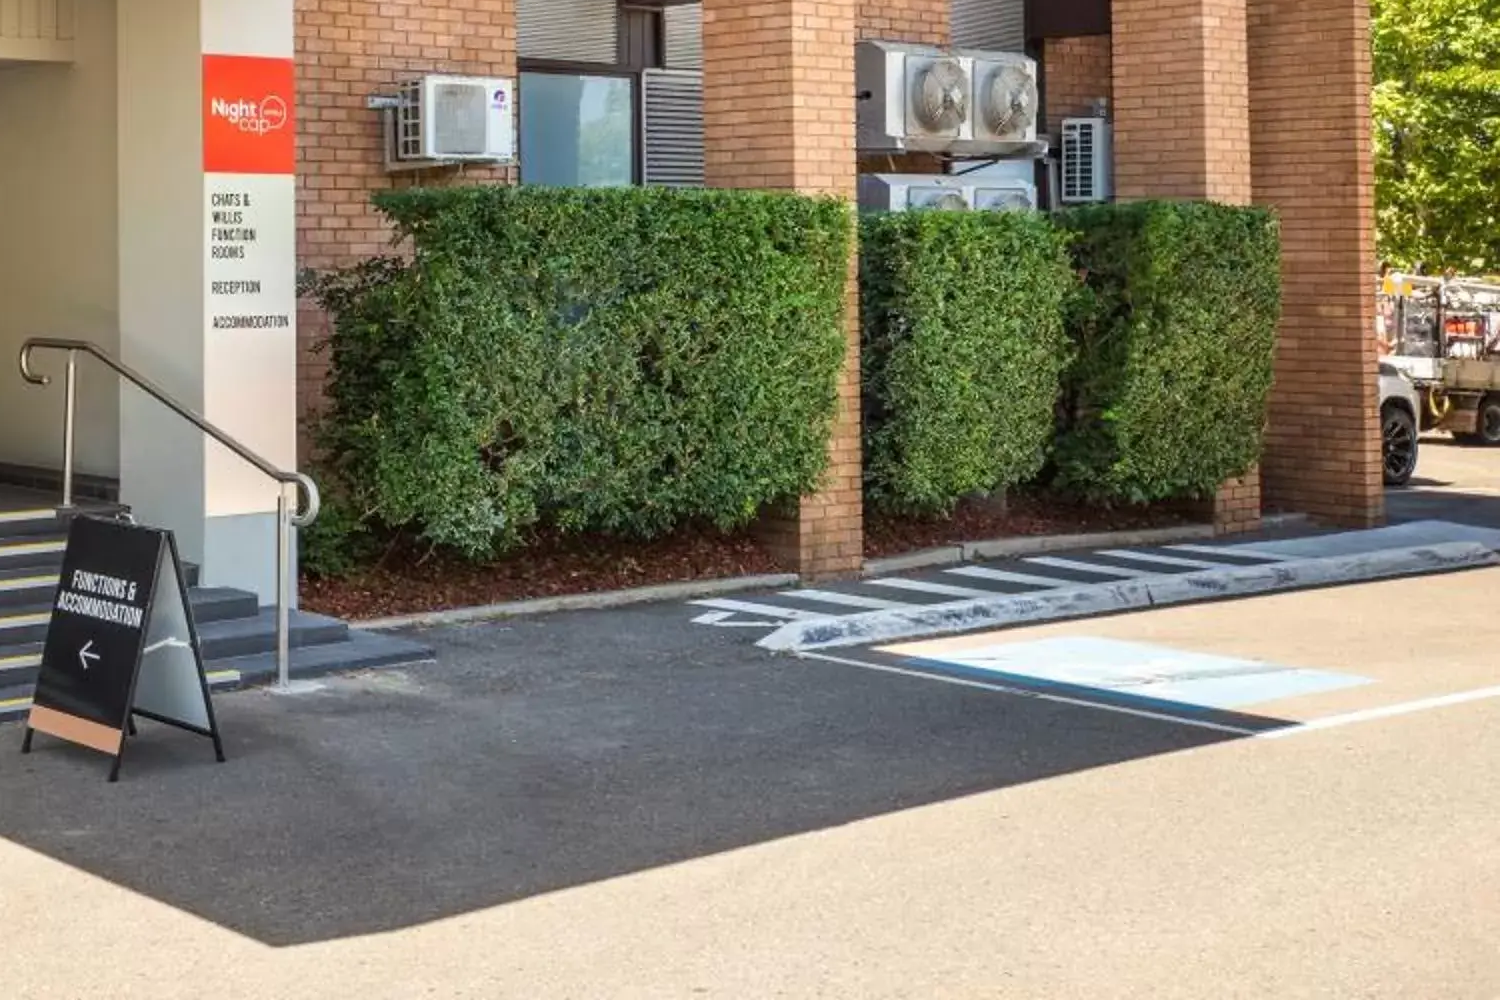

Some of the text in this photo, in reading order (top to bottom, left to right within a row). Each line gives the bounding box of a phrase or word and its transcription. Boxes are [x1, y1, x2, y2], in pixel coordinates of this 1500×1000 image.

[211, 96, 257, 123] Night
[239, 118, 270, 136] cap
[211, 193, 241, 207] CHATS
[211, 228, 256, 241] FUNCTION
[211, 245, 245, 258] ROOMS
[211, 281, 261, 295] RECEPTION
[212, 315, 289, 329] ACCOMMODATION
[71, 569, 137, 600] FUNCTIONS &
[57, 590, 144, 628] ACCOMMODATION
